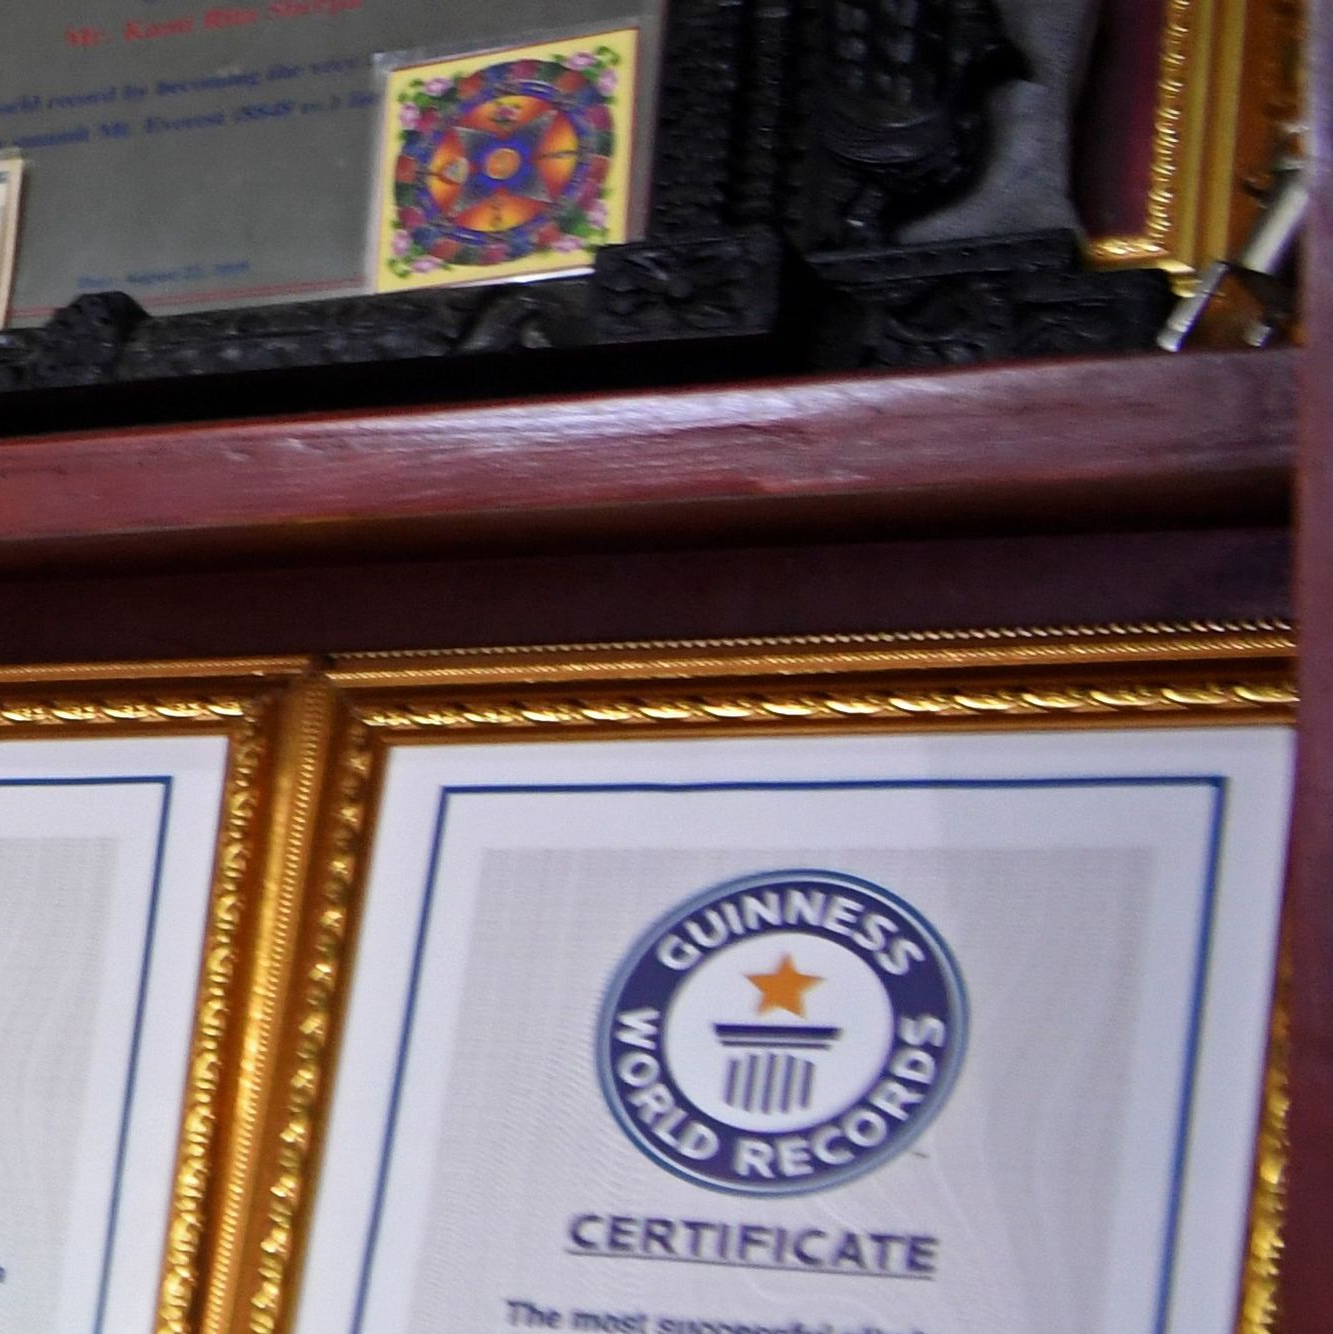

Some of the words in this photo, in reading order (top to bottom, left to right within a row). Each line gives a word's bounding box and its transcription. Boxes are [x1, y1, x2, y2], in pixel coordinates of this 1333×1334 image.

[657, 889, 924, 976] GUINNESS
[616, 1007, 720, 1160] WORLD
[734, 1014, 945, 1180] RECORDS
[569, 1213, 938, 1273] CERTIFICATE
[505, 1299, 561, 1329] The
